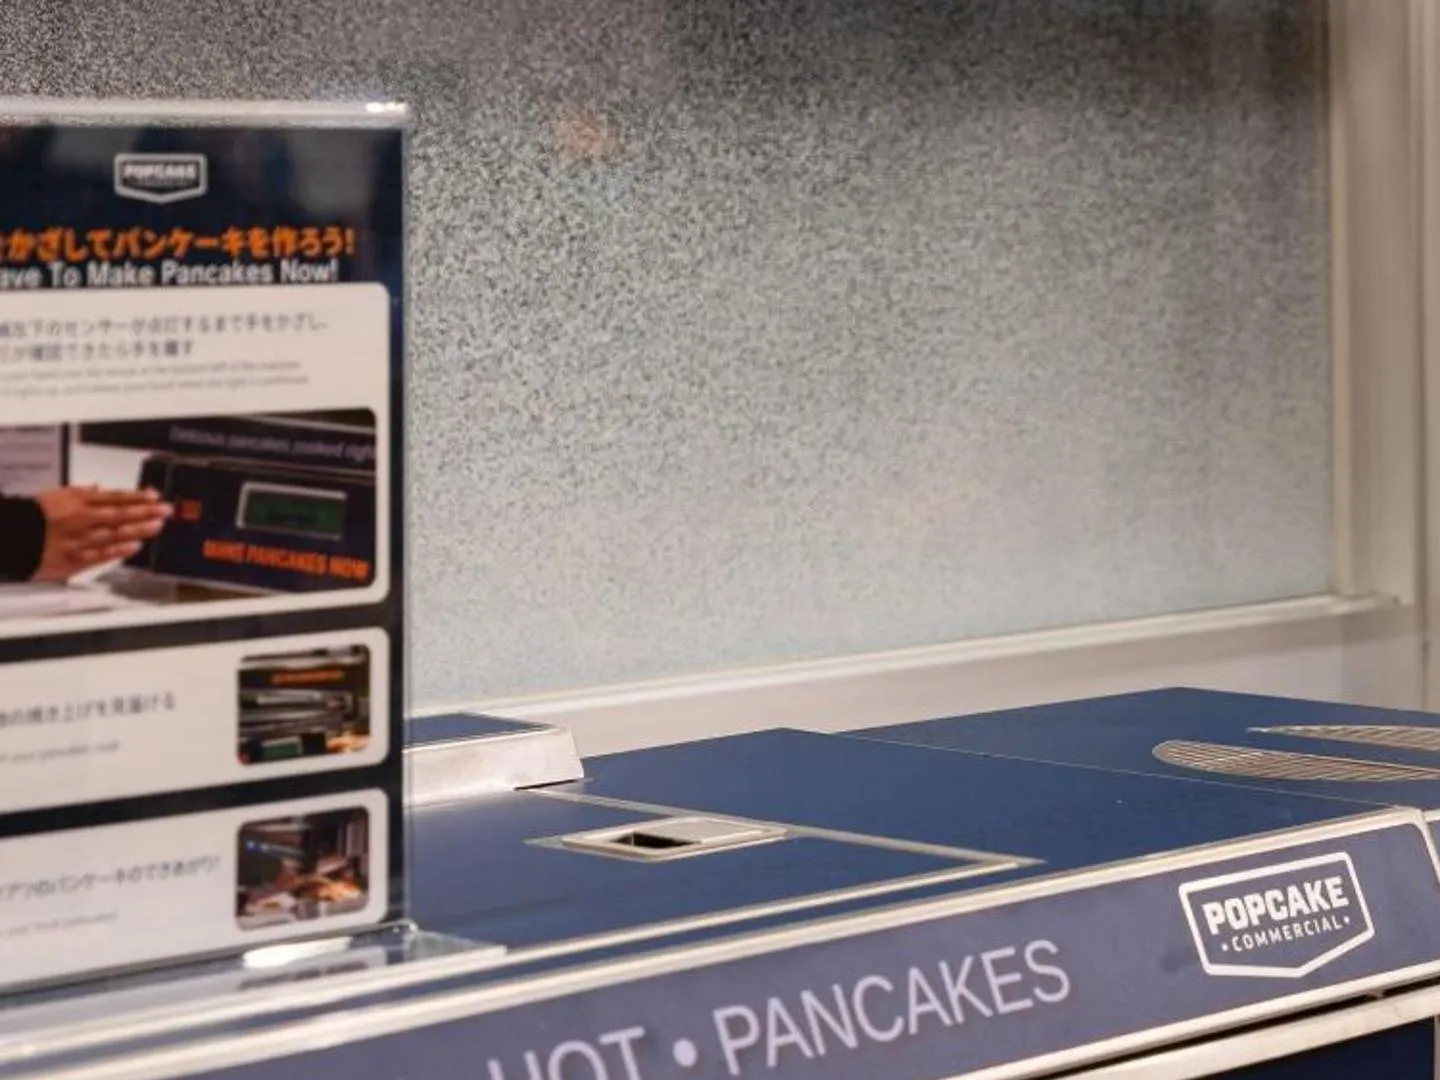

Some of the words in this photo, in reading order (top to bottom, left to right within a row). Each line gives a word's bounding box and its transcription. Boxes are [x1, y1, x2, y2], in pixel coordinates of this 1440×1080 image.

[0, 226, 355, 263] かざしてパンケーキを作ろう!
[49, 260, 82, 287] To
[86, 259, 156, 287] Make
[161, 256, 274, 285] Pancakes
[279, 256, 339, 282] Now!
[1201, 875, 1350, 936] POPCAKE
[1231, 915, 1343, 952] COMMERCIAL
[712, 939, 1071, 1076] PANCAKES
